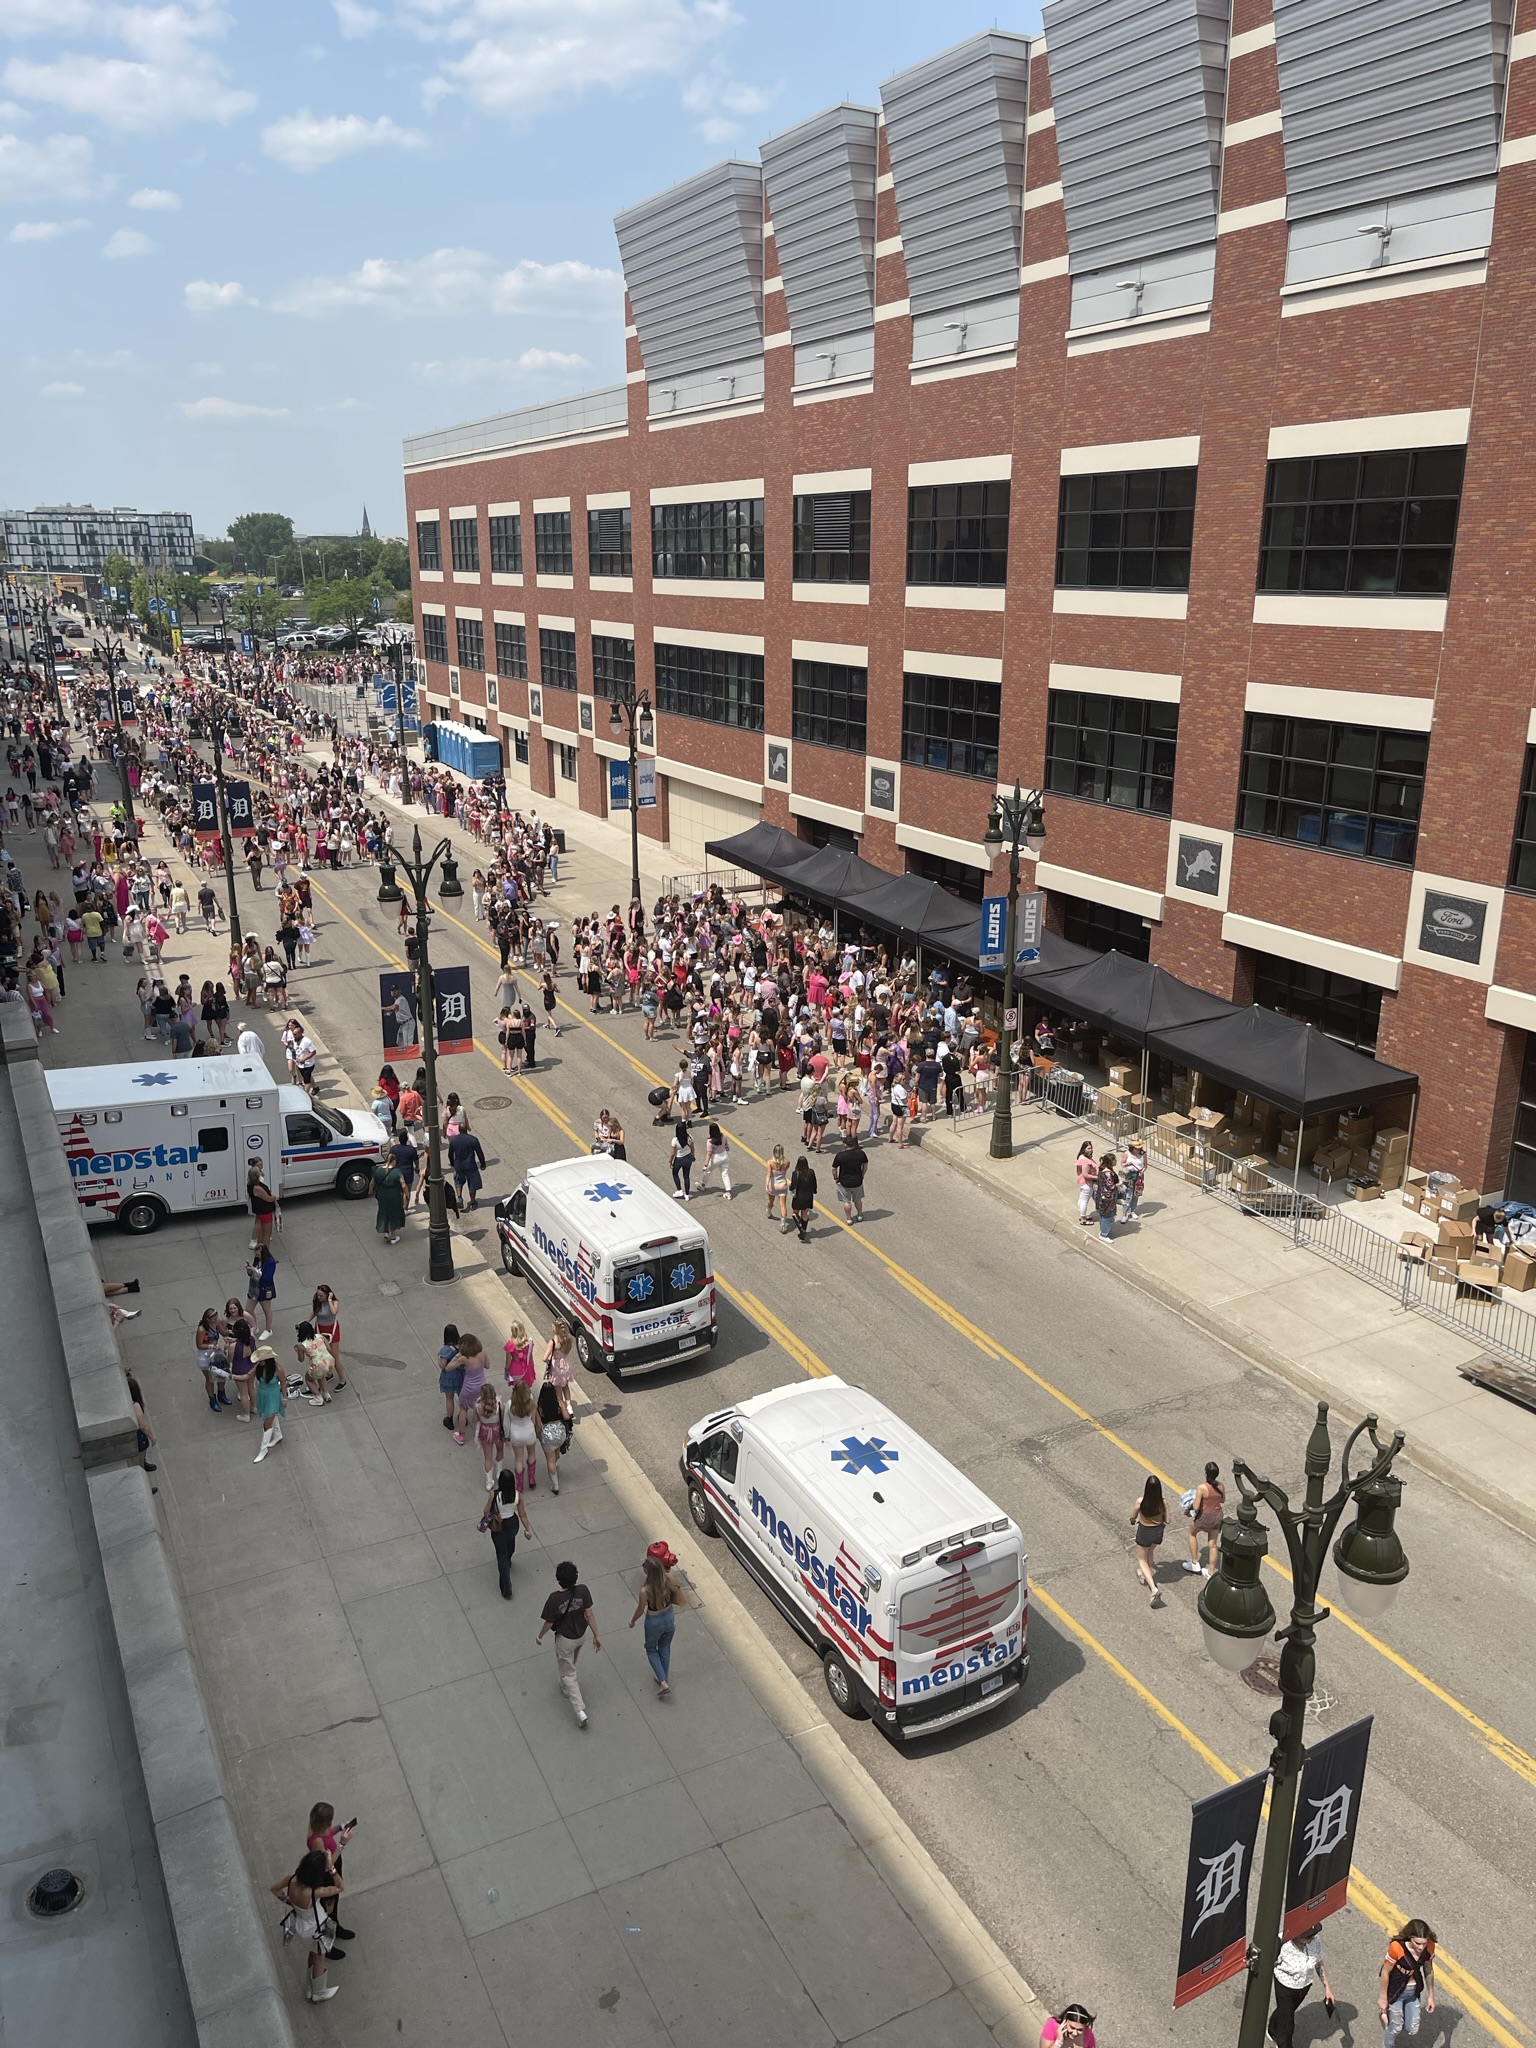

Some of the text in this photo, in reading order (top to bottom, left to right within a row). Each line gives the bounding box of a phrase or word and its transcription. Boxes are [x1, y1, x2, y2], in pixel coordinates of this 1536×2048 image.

[196, 799, 214, 822] D
[231, 797, 249, 820] D
[987, 903, 1001, 949] LIONS
[1024, 899, 1037, 943] LIONS
[1441, 910, 1465, 926] Ford
[440, 991, 467, 1027] D
[210, 1188, 227, 1198] 911
[1298, 1783, 1353, 1877] D
[1190, 1840, 1246, 1939] D
